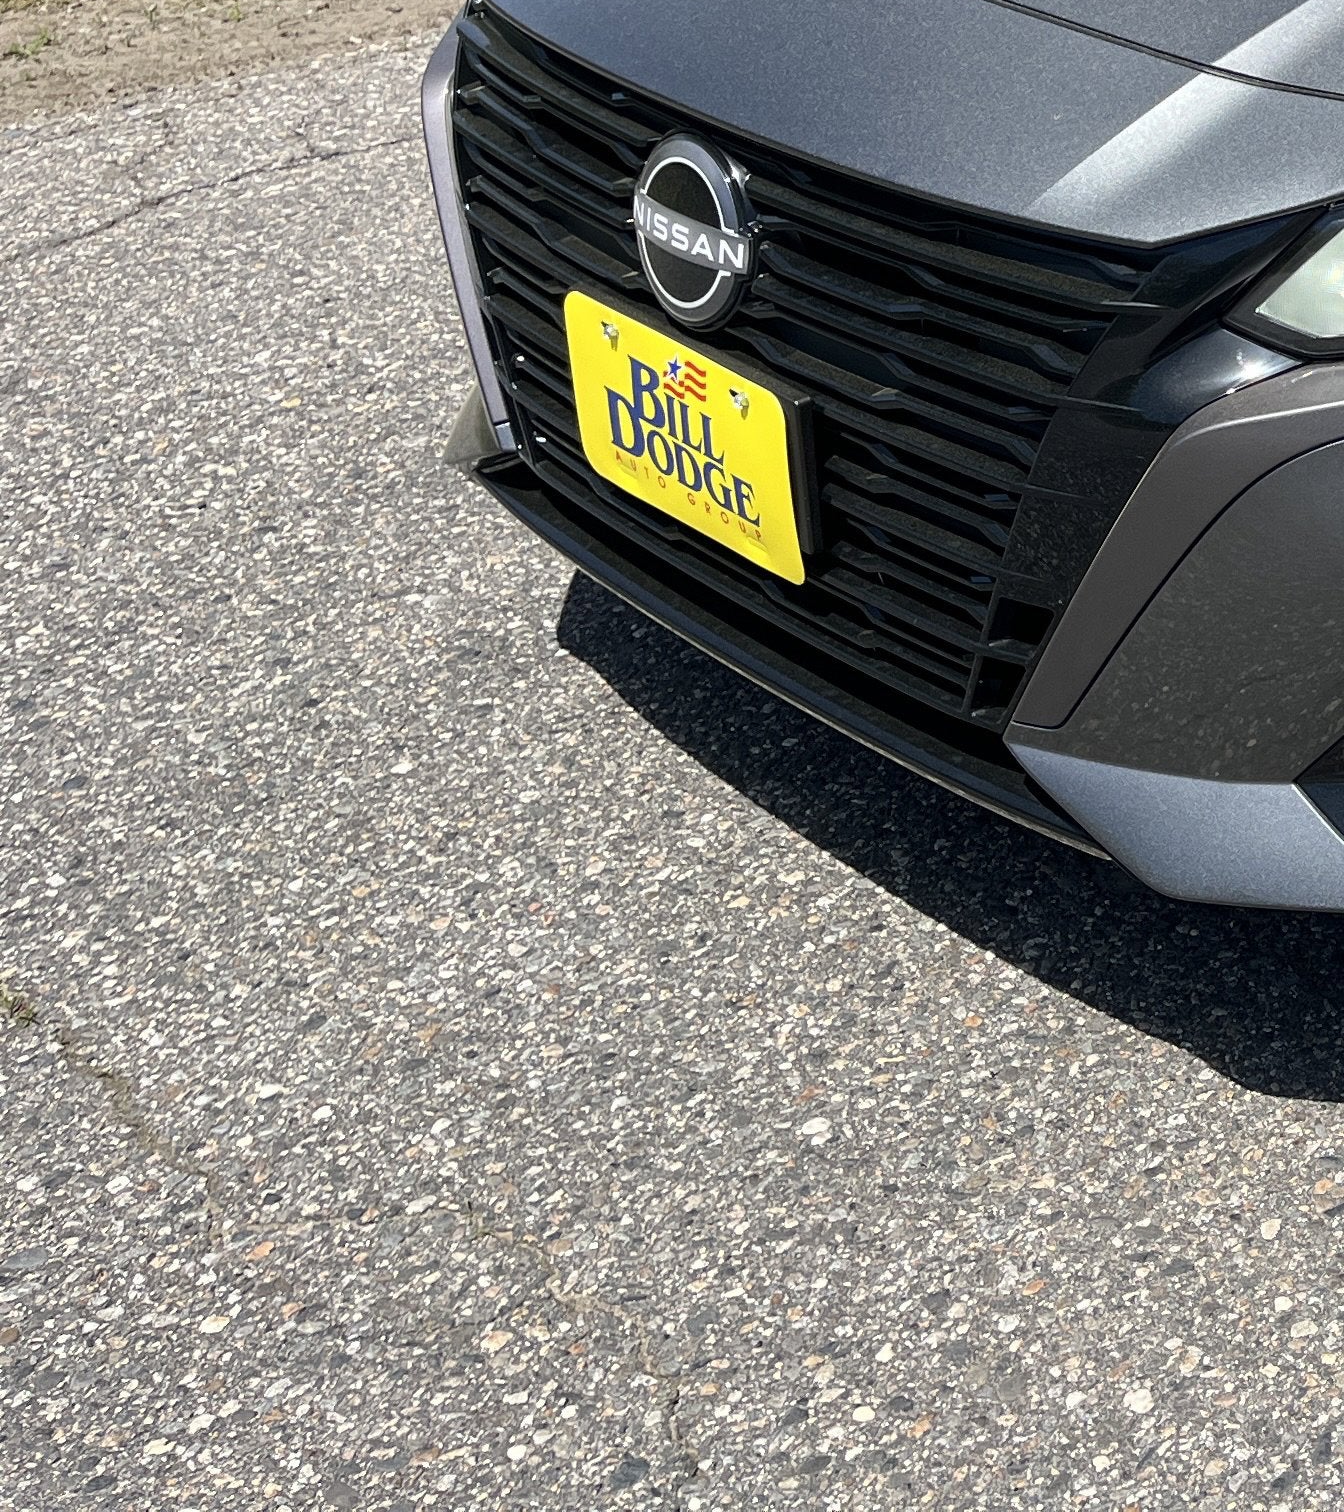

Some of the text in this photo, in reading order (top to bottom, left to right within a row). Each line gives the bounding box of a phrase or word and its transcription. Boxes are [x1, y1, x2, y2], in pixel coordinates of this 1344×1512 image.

[633, 195, 745, 269] NISSAN
[604, 385, 761, 528] DODGE
[627, 354, 725, 466] BILL
[615, 450, 763, 540] AUTO GROUP
